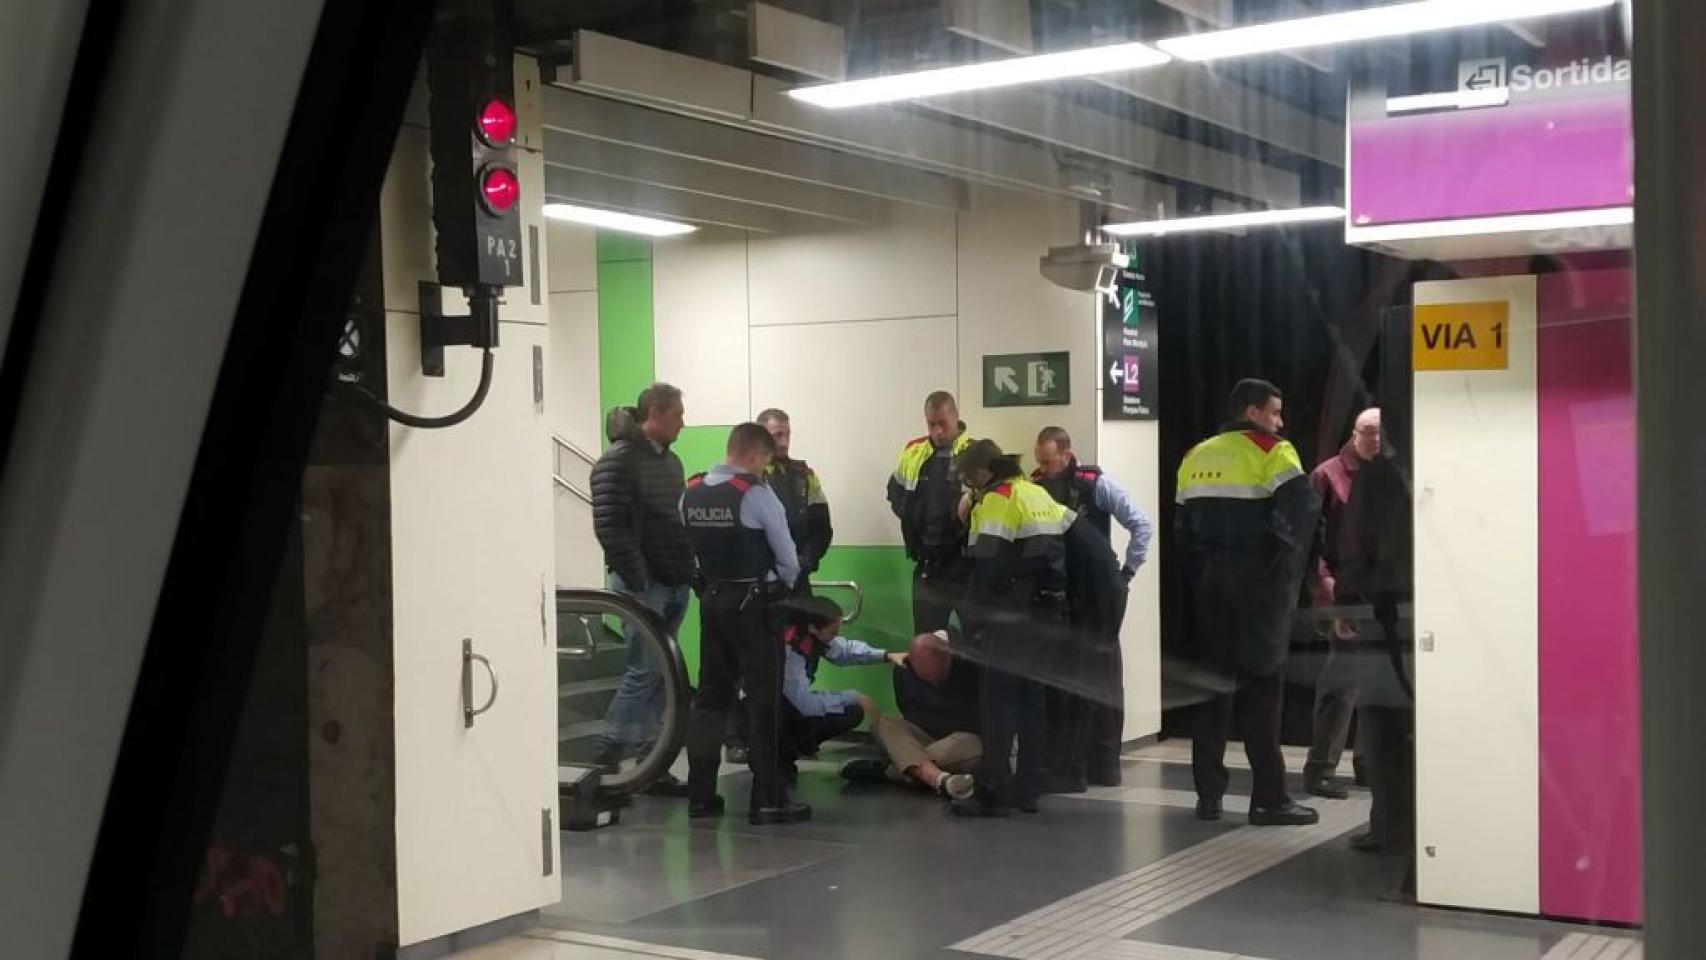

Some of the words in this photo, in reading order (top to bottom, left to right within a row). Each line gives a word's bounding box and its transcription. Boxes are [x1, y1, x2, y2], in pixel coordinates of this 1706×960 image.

[1510, 55, 1631, 92] Sortida
[1421, 322, 1476, 350] VIA
[1491, 322, 1502, 349] 1
[1124, 362, 1139, 384] L2
